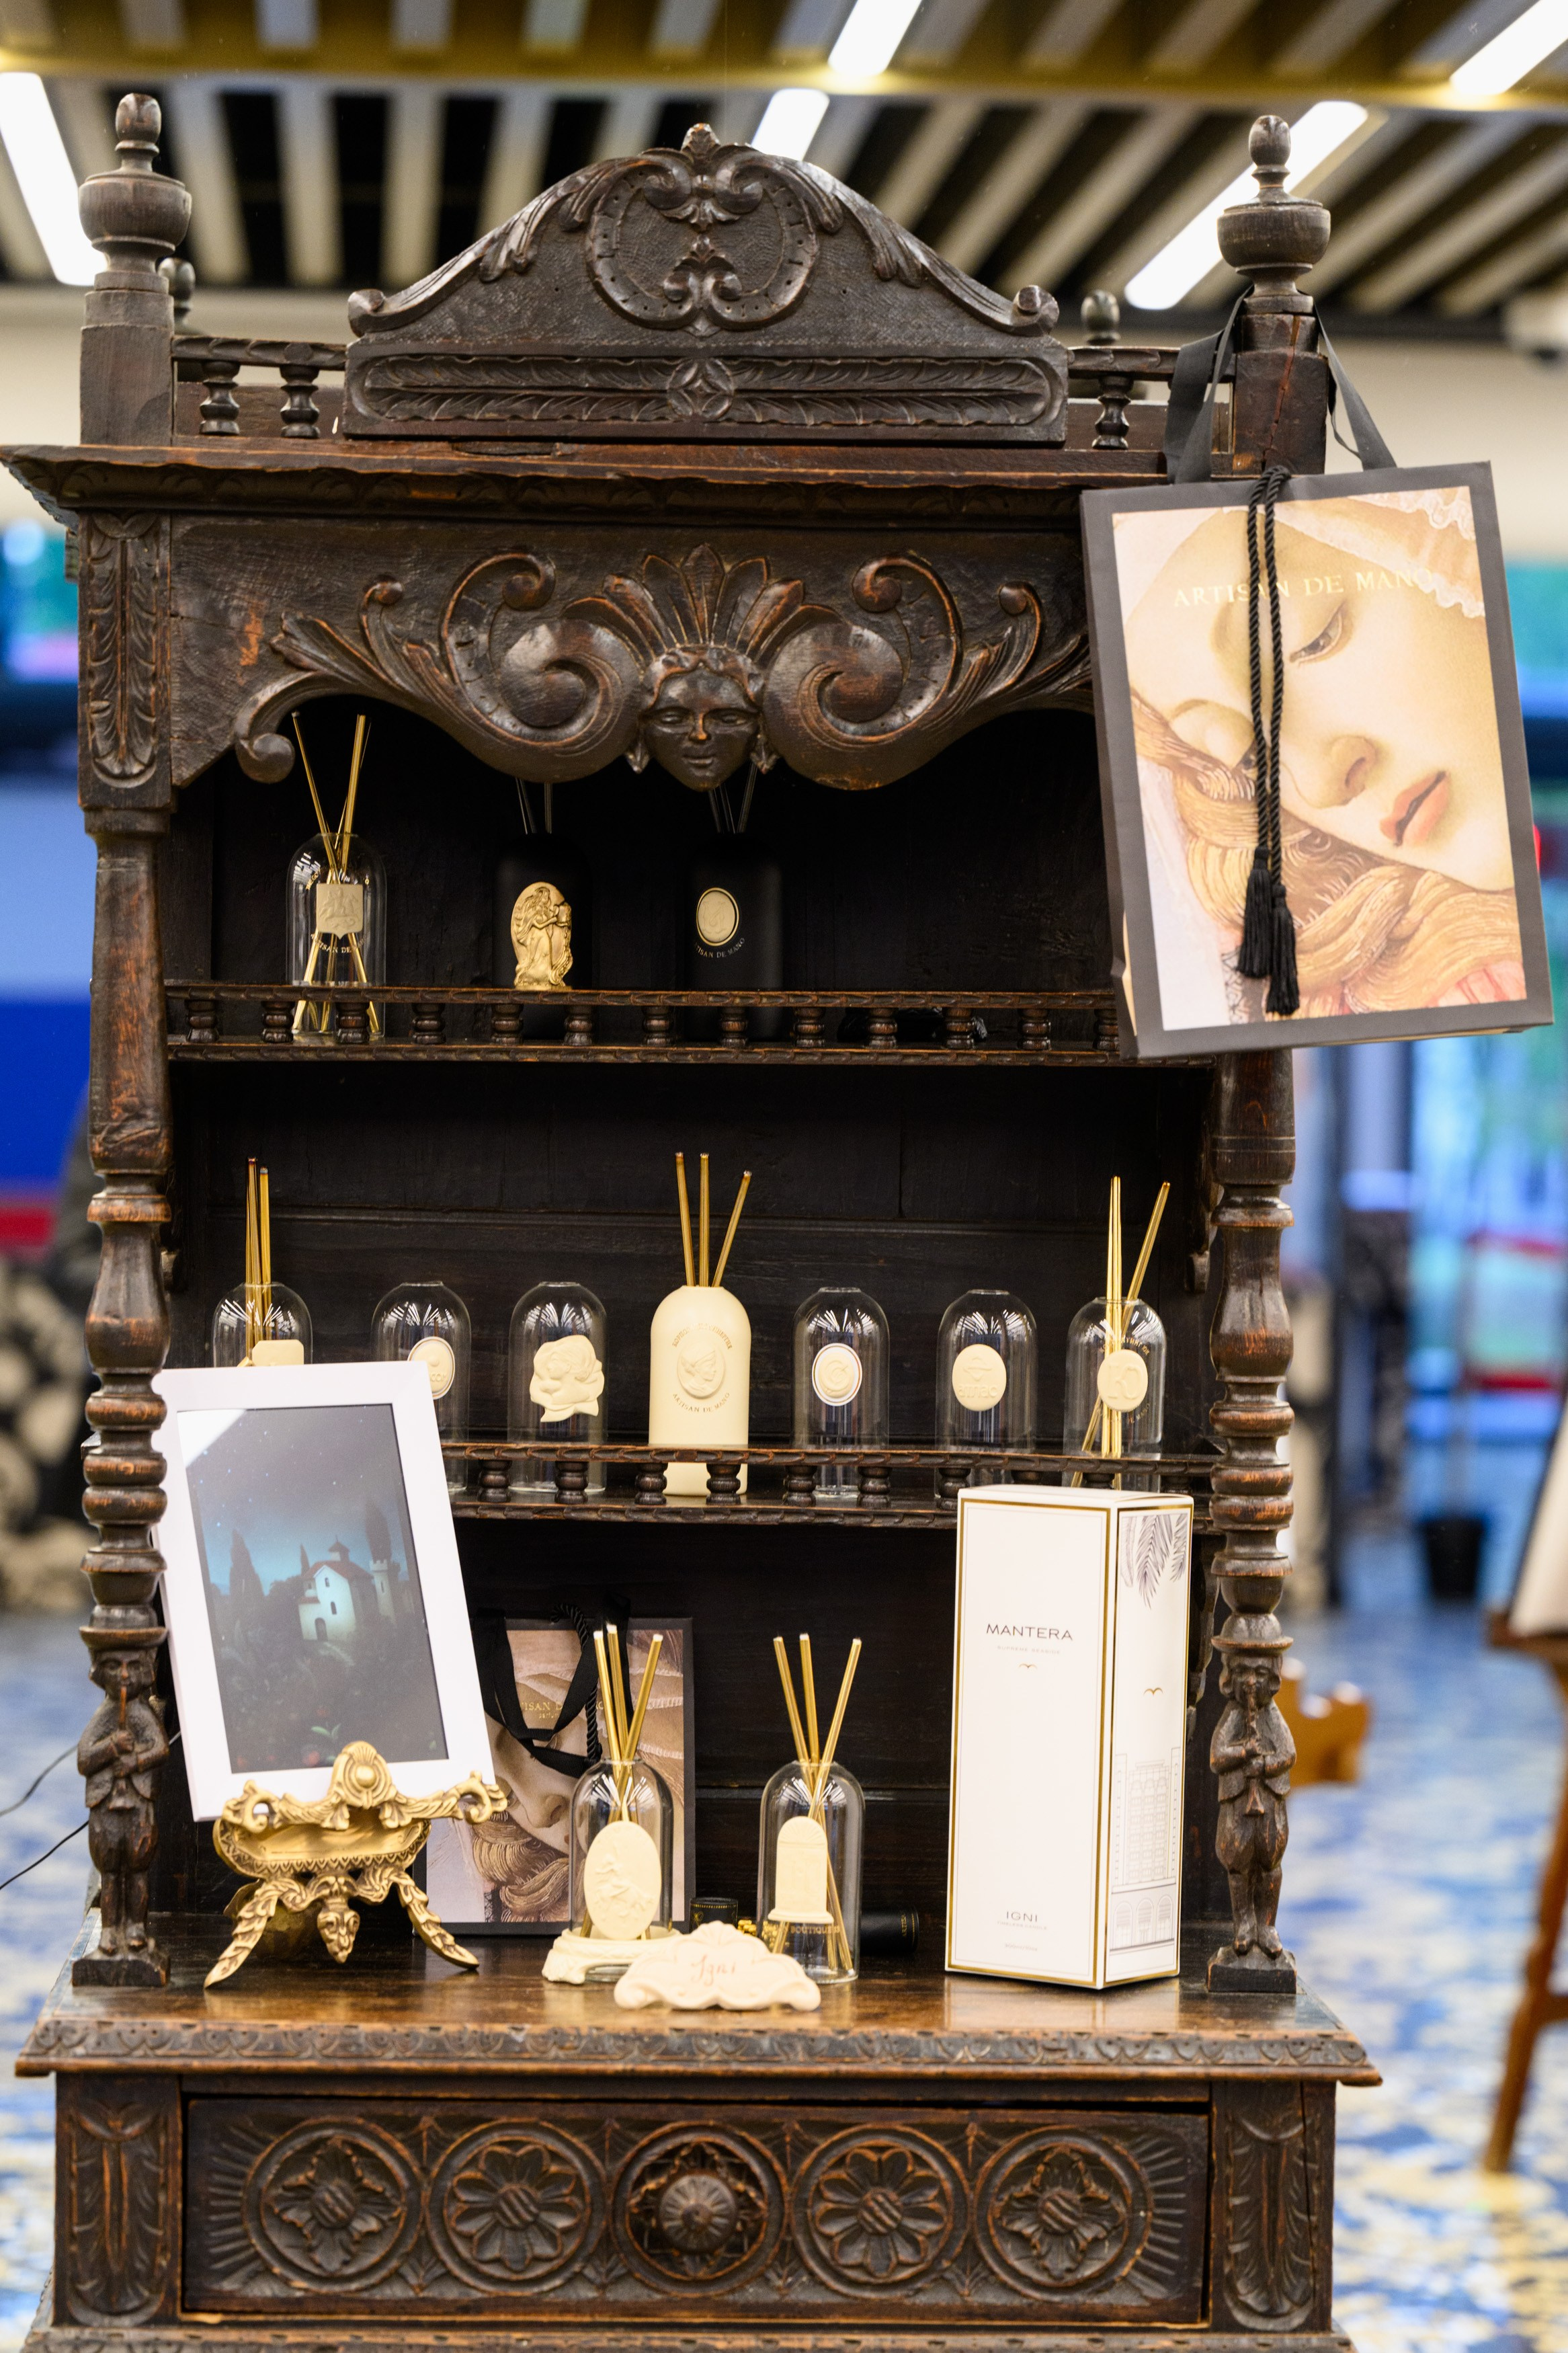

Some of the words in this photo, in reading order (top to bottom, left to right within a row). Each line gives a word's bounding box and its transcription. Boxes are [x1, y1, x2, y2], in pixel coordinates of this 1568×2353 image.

[1304, 575, 1344, 596] DE
[1355, 567, 1433, 592] MANO
[673, 1393, 700, 1412] ARTISAN
[714, 1392, 730, 1410] MANO
[986, 1624, 1073, 1640] MANTERA
[1006, 1911, 1038, 1923] IGNI
